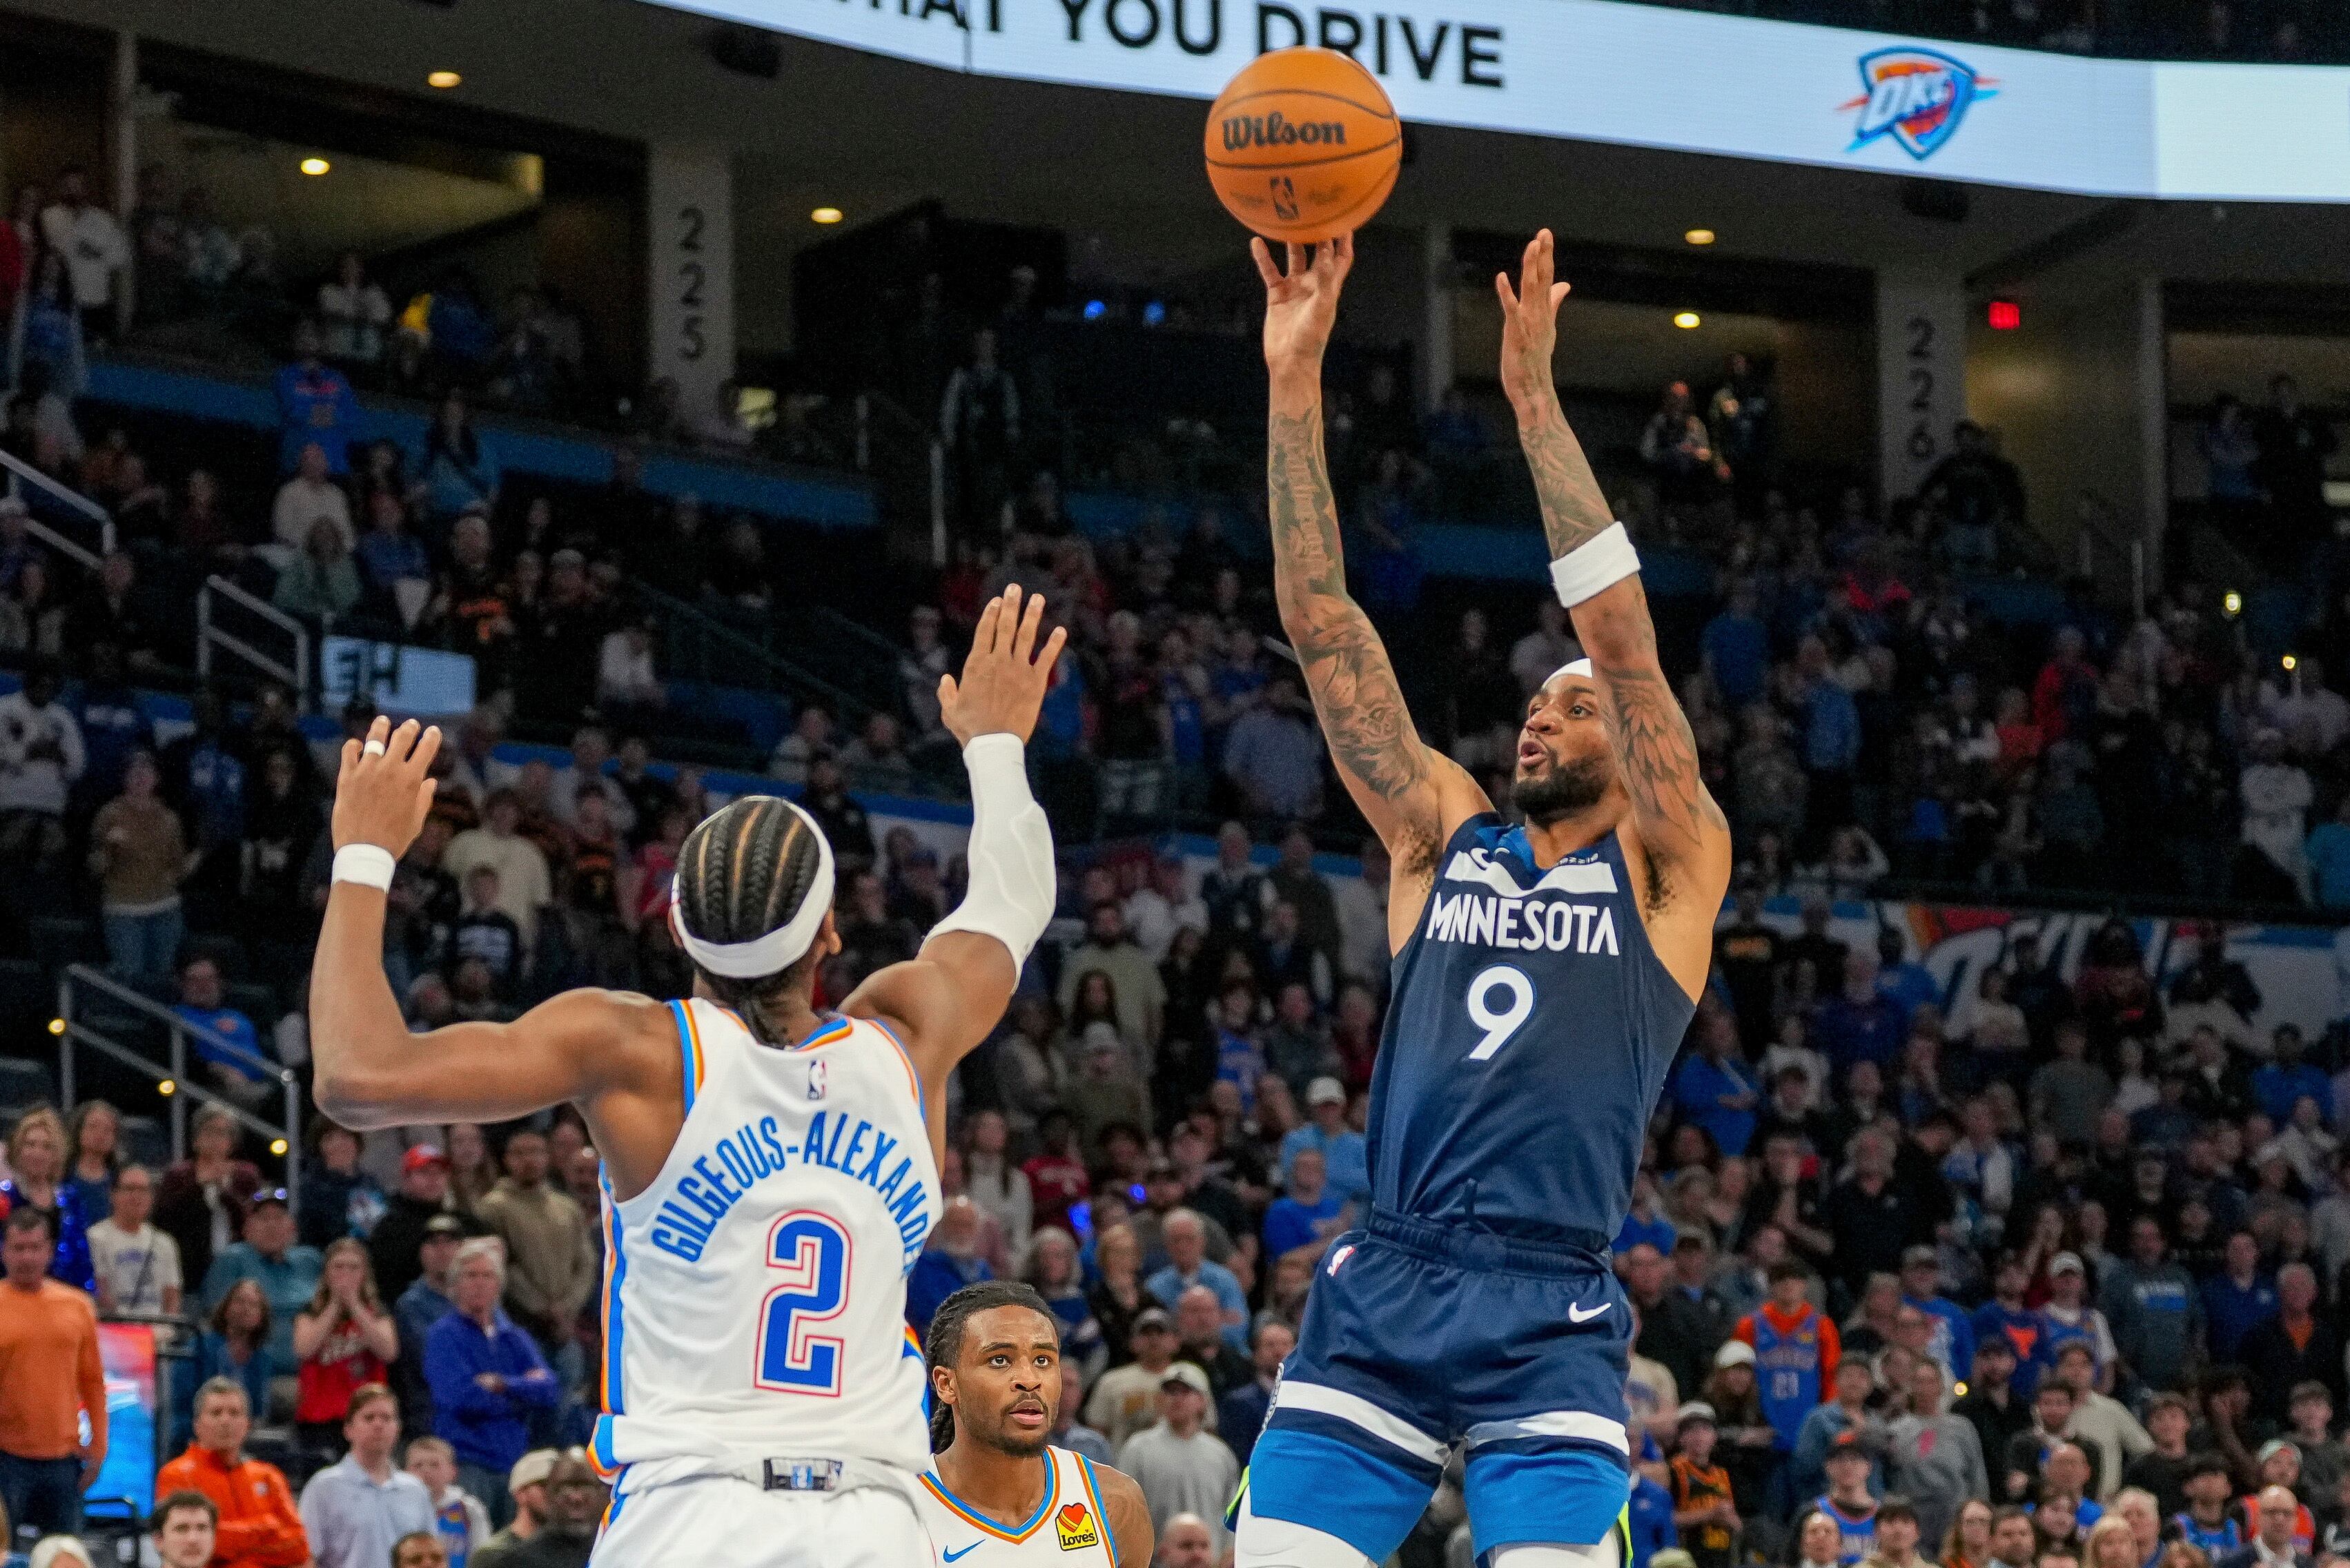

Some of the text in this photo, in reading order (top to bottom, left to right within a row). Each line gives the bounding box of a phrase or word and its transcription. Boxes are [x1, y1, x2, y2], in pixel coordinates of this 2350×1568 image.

[1060, 0, 1221, 56] YOU
[1257, 2, 1504, 88] DRIVE
[1222, 110, 1345, 152] Wilson
[677, 208, 705, 360] 225
[1907, 317, 1933, 457] 226
[1466, 963, 1536, 1061] 9
[754, 1210, 852, 1398] 2
